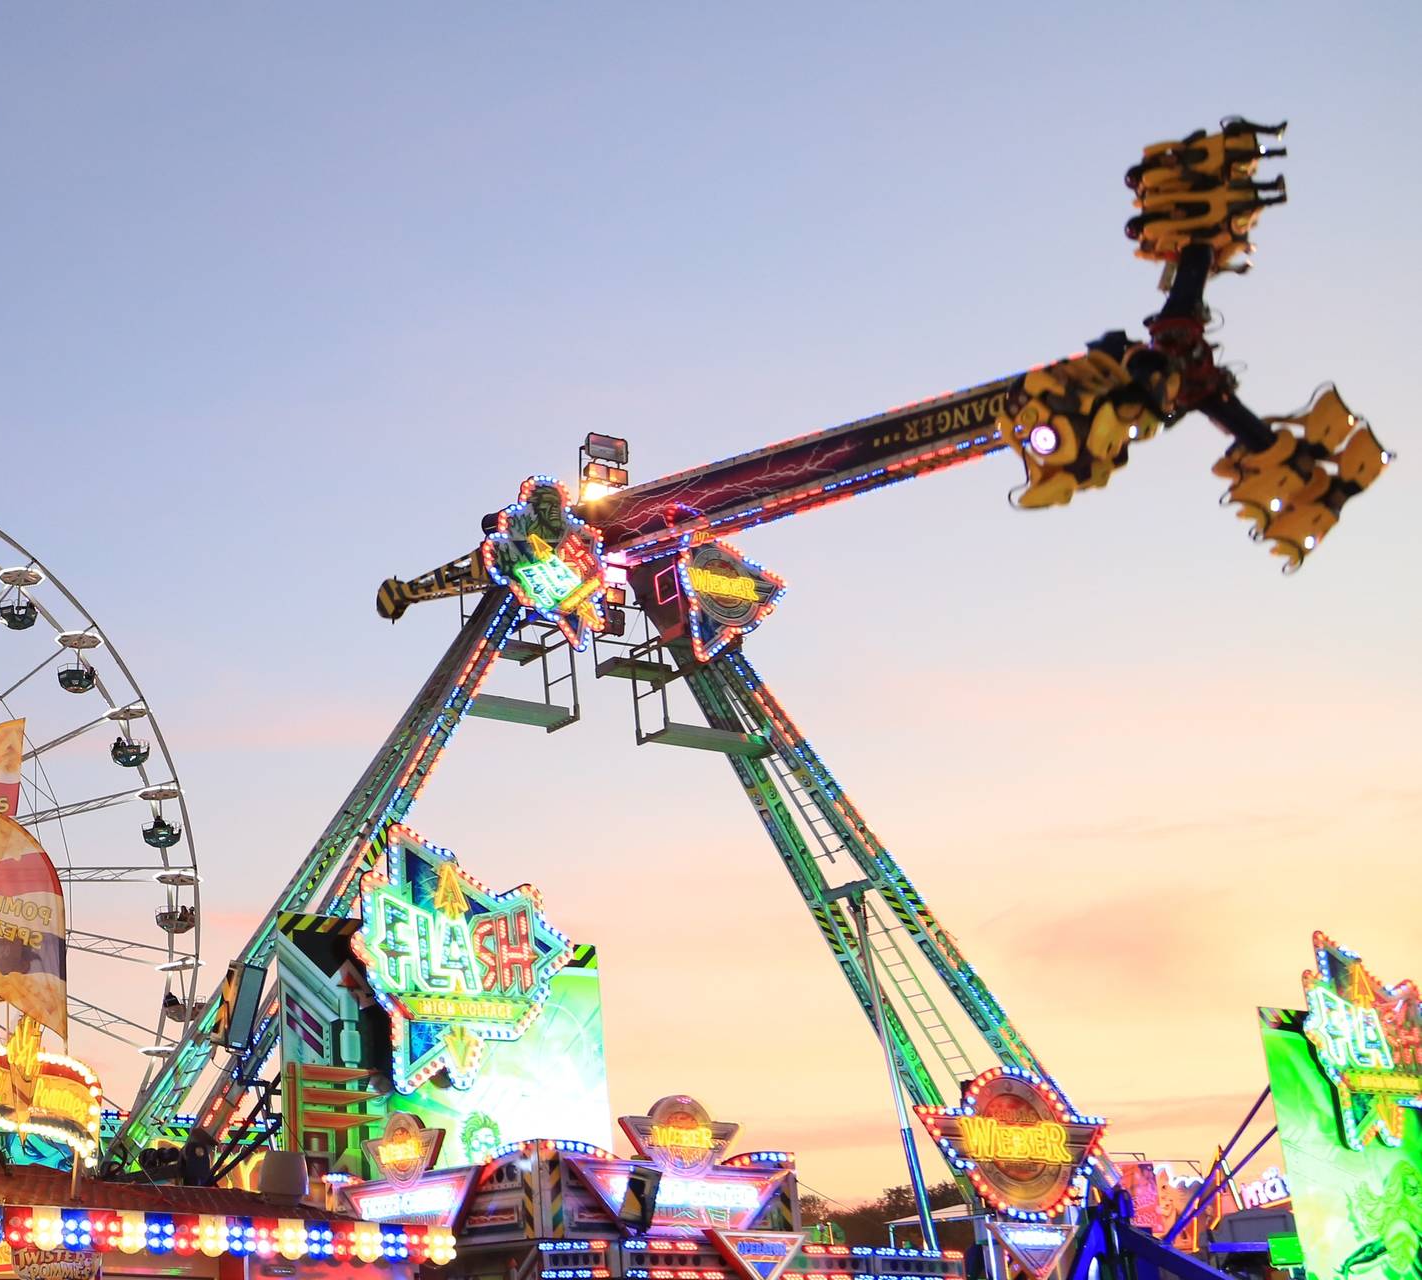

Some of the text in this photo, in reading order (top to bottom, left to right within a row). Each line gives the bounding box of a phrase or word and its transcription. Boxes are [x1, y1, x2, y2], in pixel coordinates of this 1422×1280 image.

[373, 894, 538, 995] FLASH
[651, 1126, 715, 1149] WEBER
[957, 1117, 1072, 1163] WEBER
